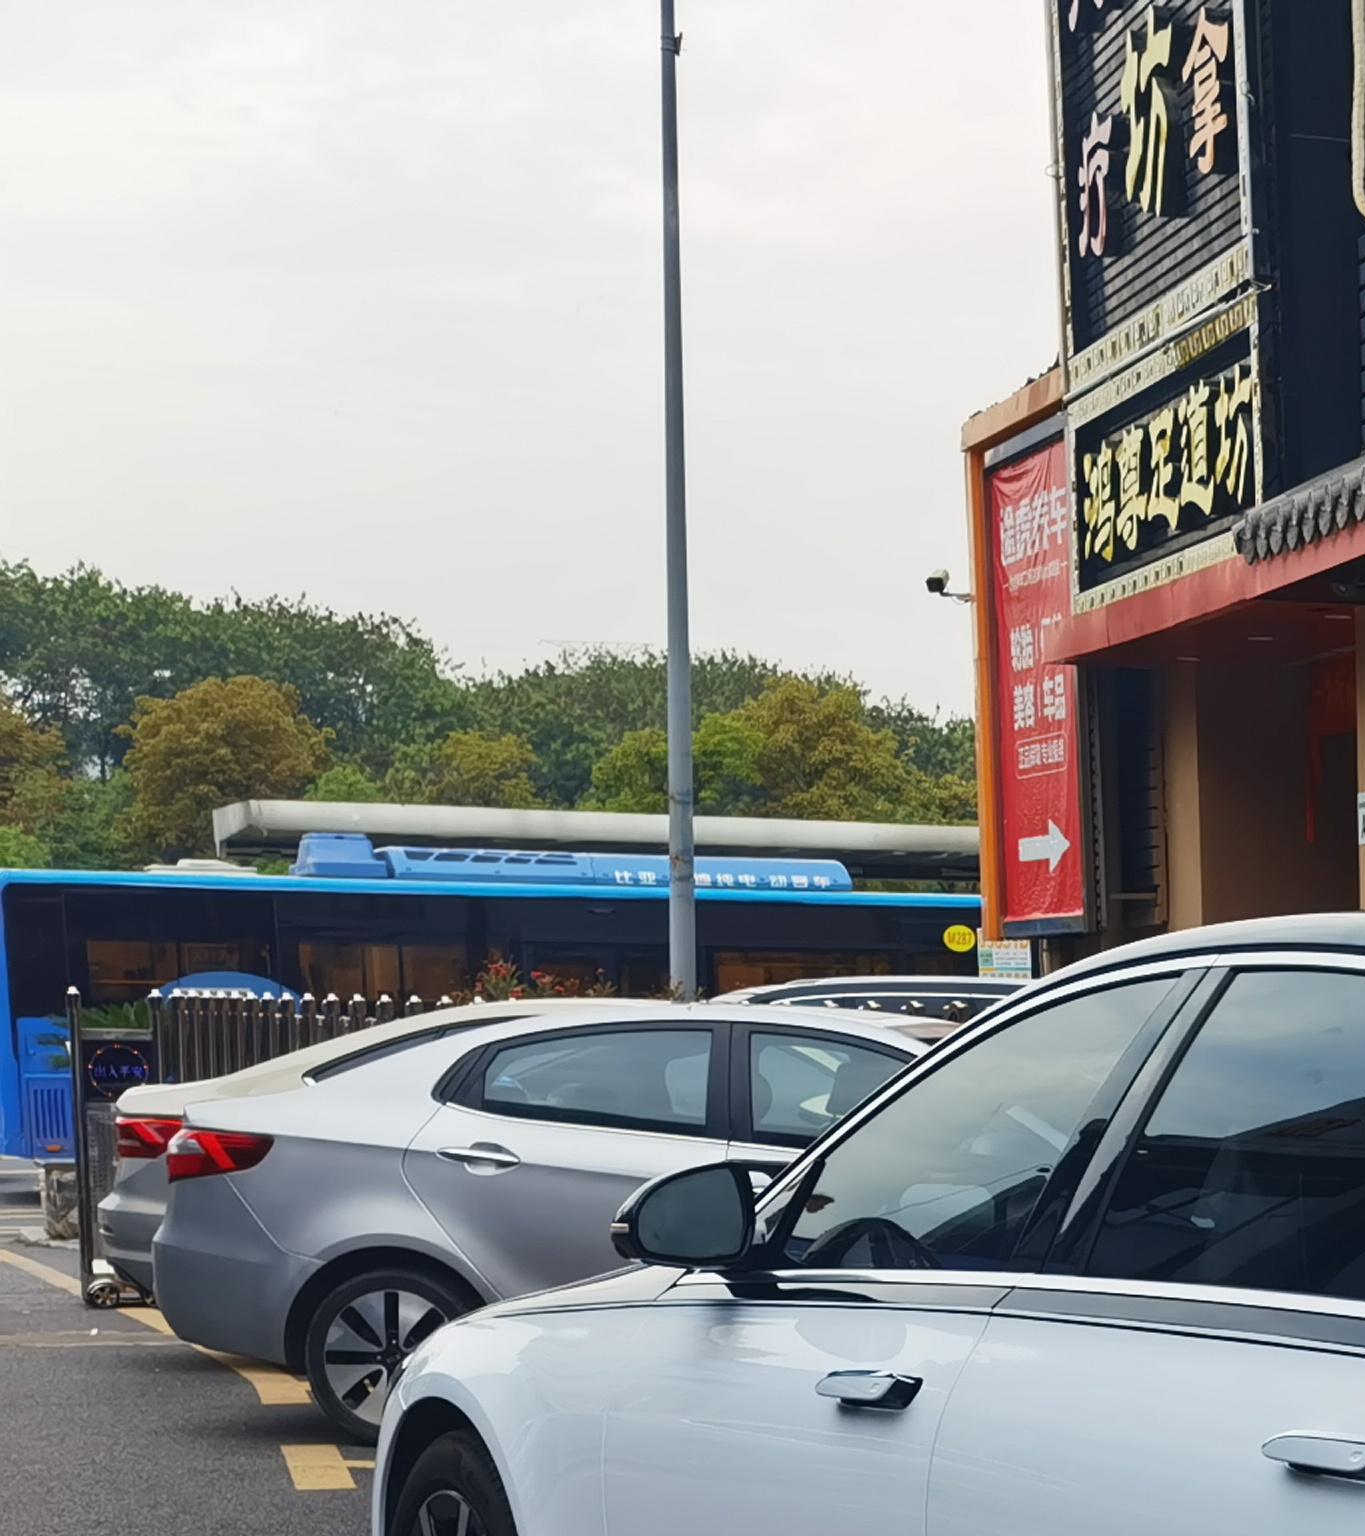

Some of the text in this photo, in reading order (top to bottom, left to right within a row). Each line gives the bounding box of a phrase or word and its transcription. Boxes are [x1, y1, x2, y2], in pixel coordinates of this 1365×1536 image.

[1120, 3, 1172, 218] 坊
[1181, 5, 1229, 175] 拿
[1083, 363, 1252, 562] 鸿尊足道坊
[94, 1064, 145, 1079] 出入平安
